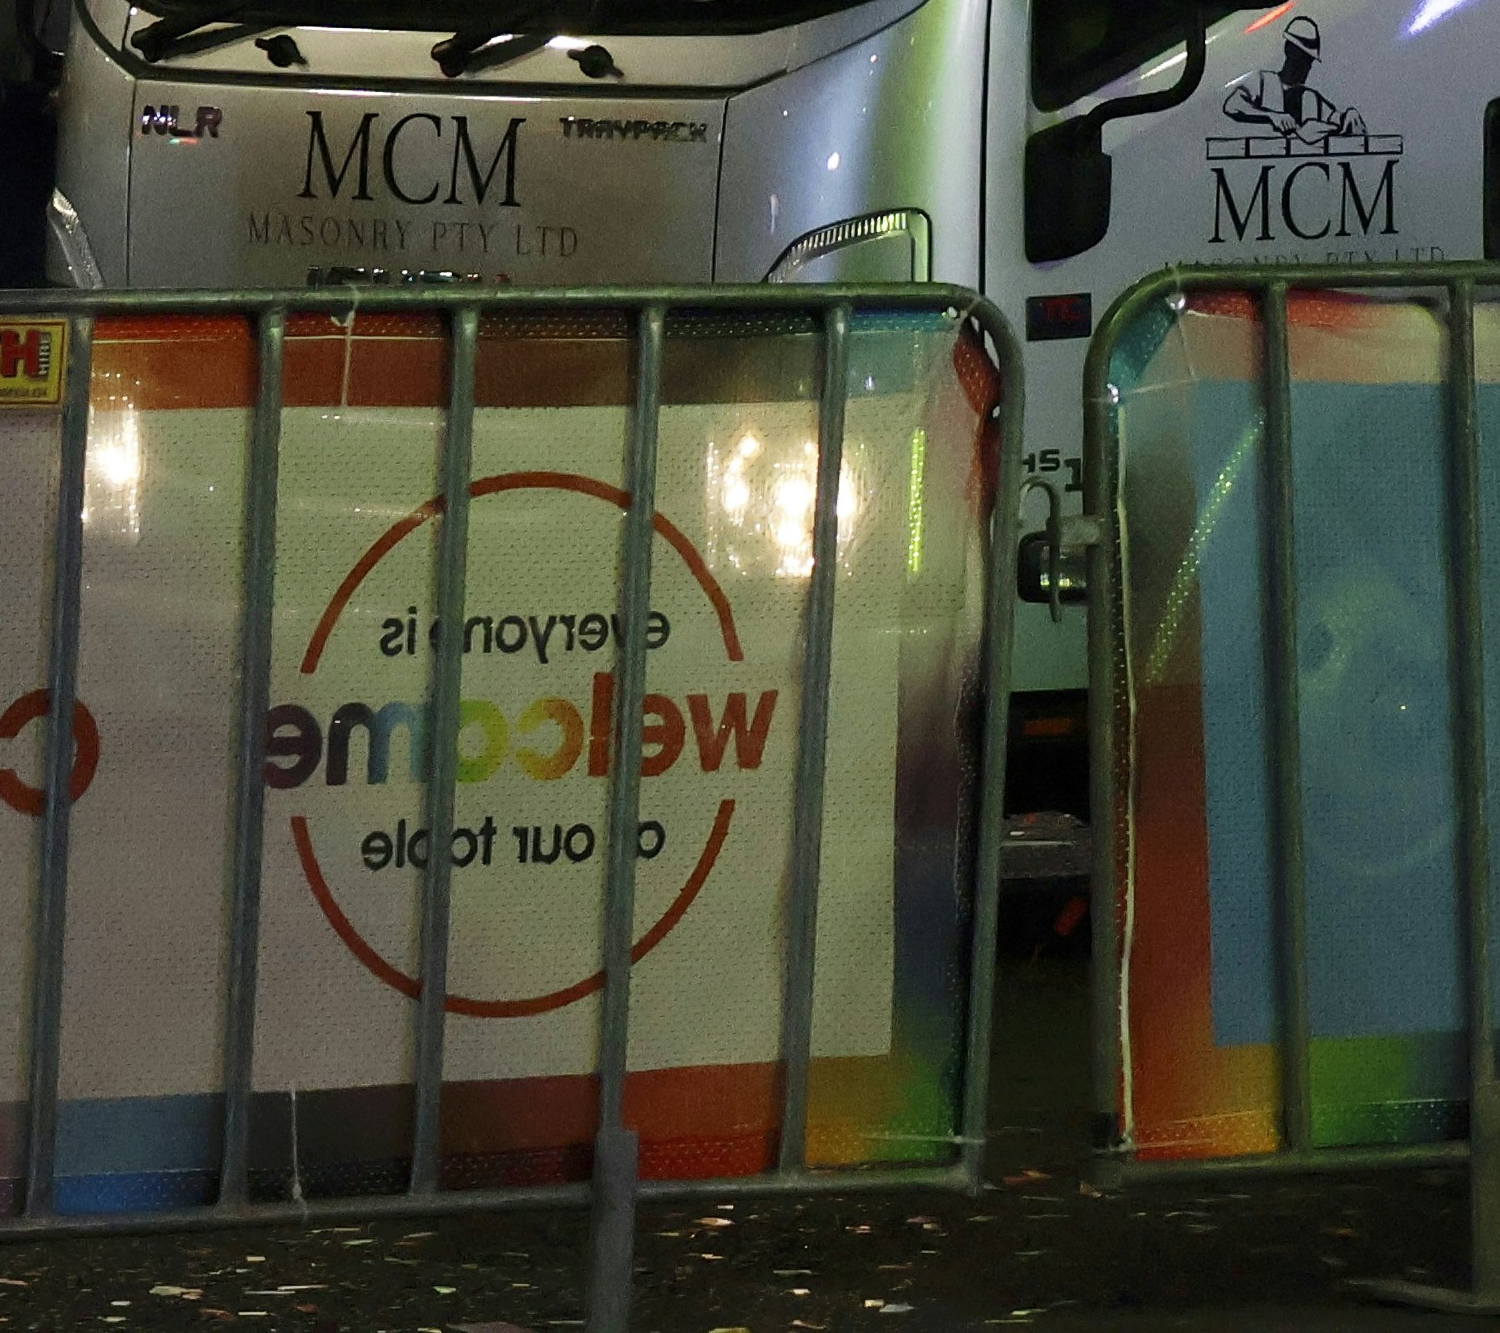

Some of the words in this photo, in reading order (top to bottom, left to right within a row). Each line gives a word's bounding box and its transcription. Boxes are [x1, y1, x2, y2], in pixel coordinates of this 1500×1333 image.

[141, 104, 224, 138] NLR
[298, 110, 527, 208] MCM
[247, 211, 408, 253] MASONRY
[432, 220, 493, 255] PTY
[516, 223, 579, 258] LTD
[1207, 159, 1400, 244] MCM
